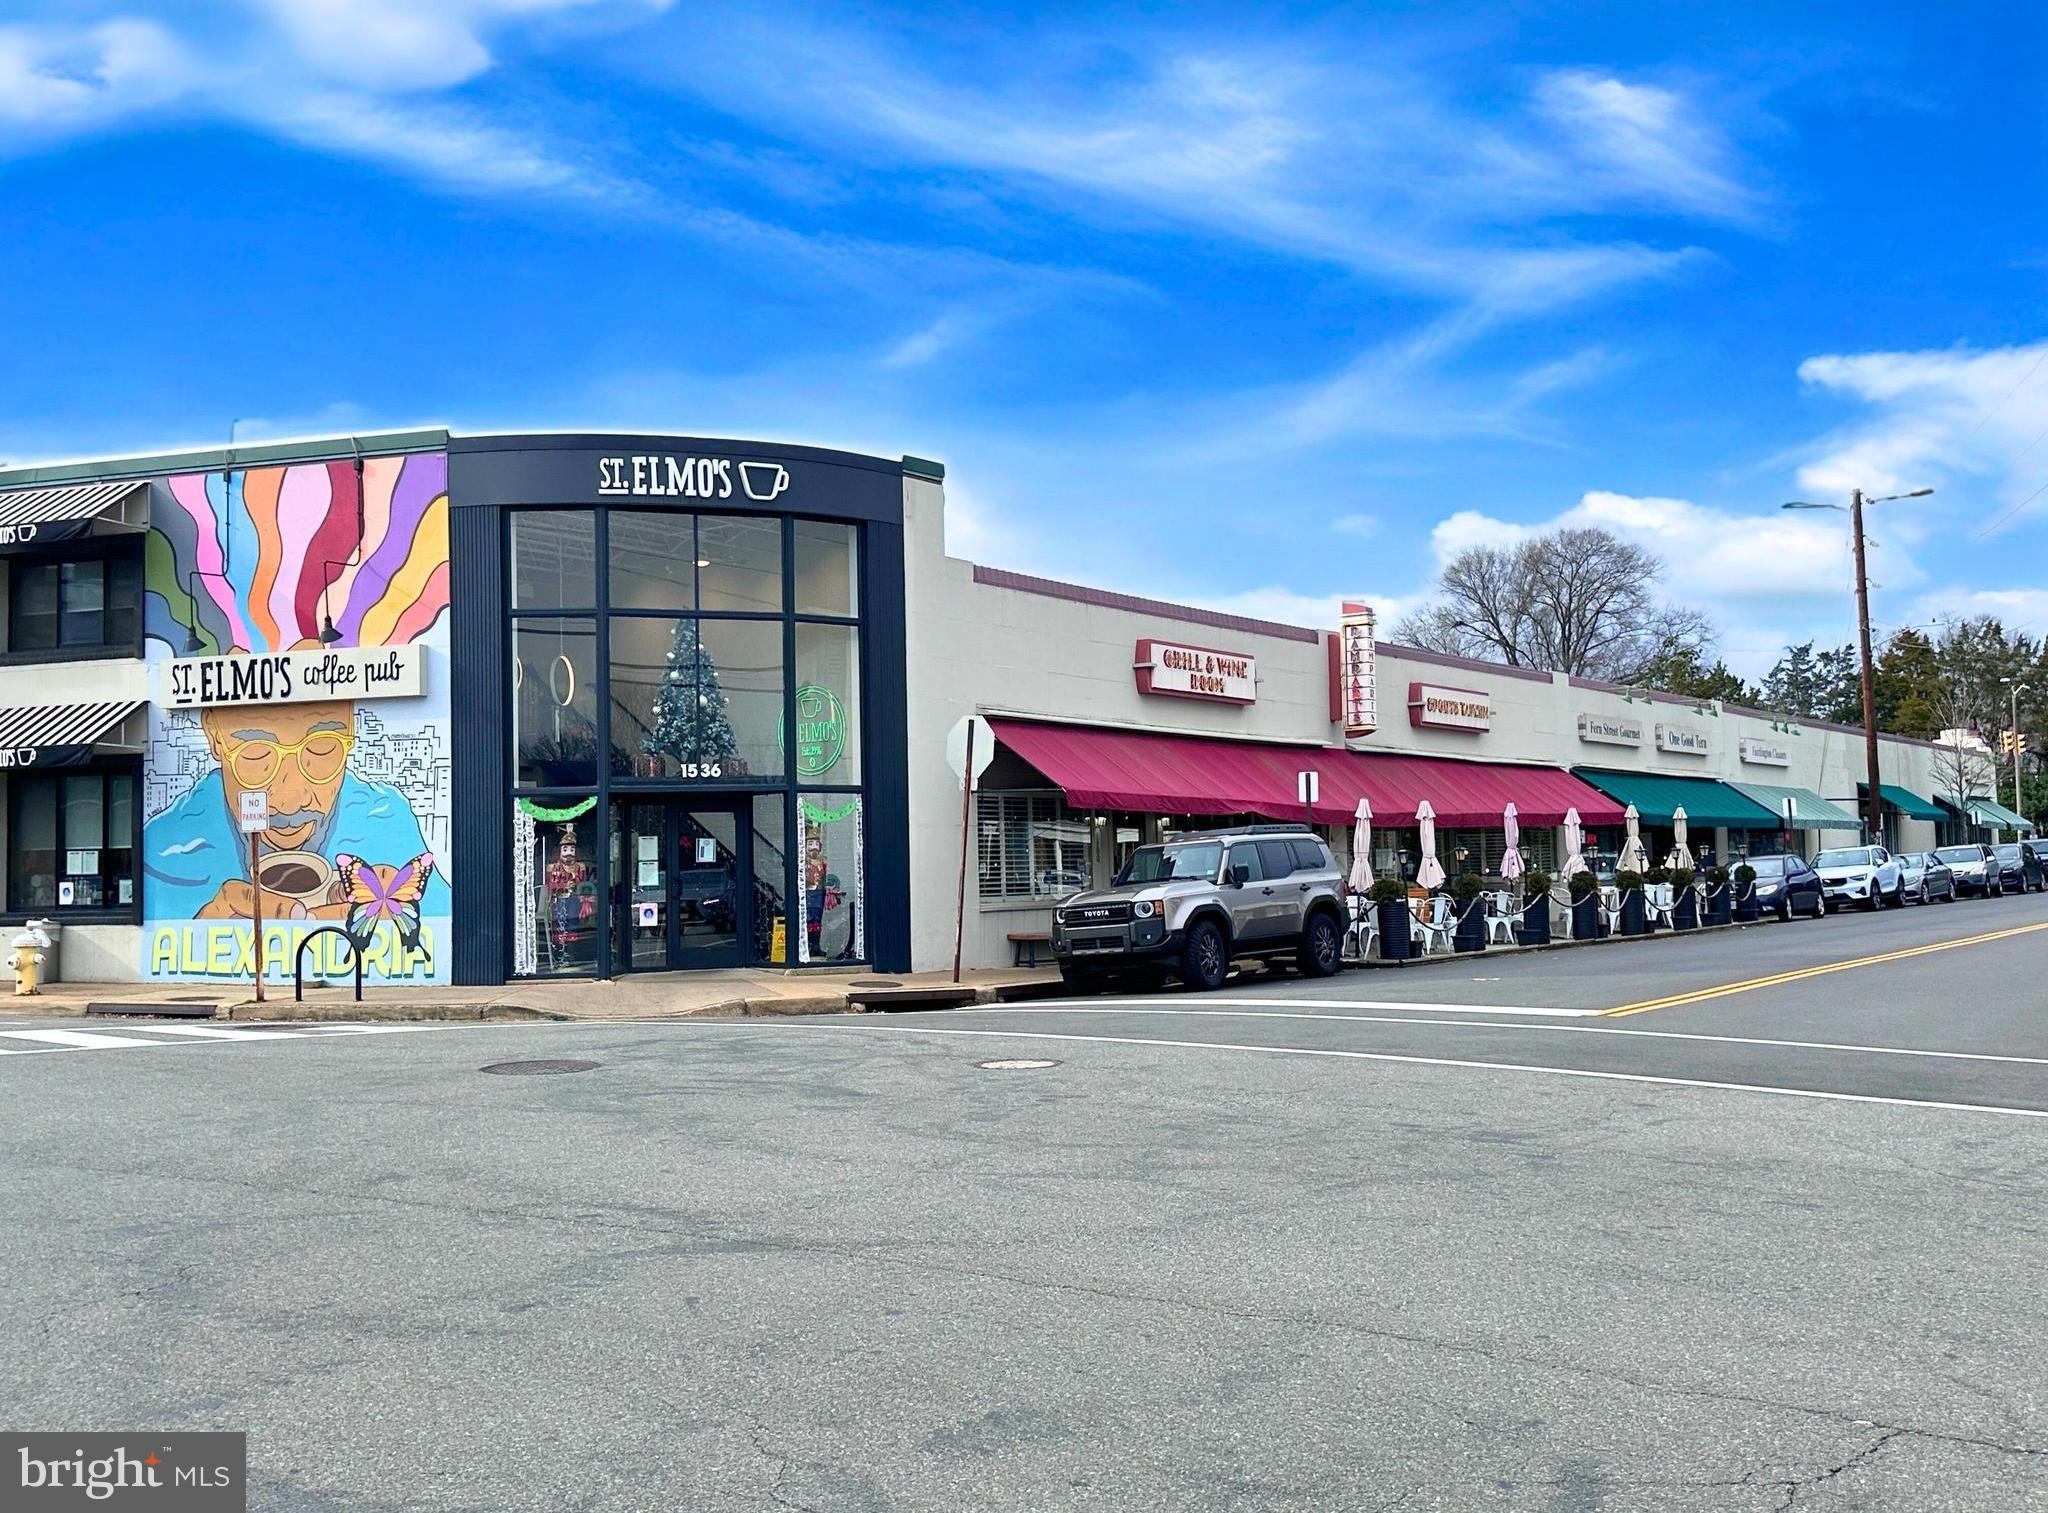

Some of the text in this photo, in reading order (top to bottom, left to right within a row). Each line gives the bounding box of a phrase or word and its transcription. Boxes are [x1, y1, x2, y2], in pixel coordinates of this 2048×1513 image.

[599, 456, 733, 498] ST. ELMO'S
[1163, 649, 1247, 679] GRILL & WINE
[1368, 626, 1376, 721] RAMPARTS
[172, 651, 404, 704] ST. ELMO'S coffee pub
[1190, 673, 1224, 693] ROOM
[799, 721, 837, 742] ELMO'S
[1668, 731, 1707, 749] One Good Tern
[248, 799, 259, 808] NO
[242, 813, 266, 821] PARKING
[151, 926, 435, 979] ALEXANDRIA
